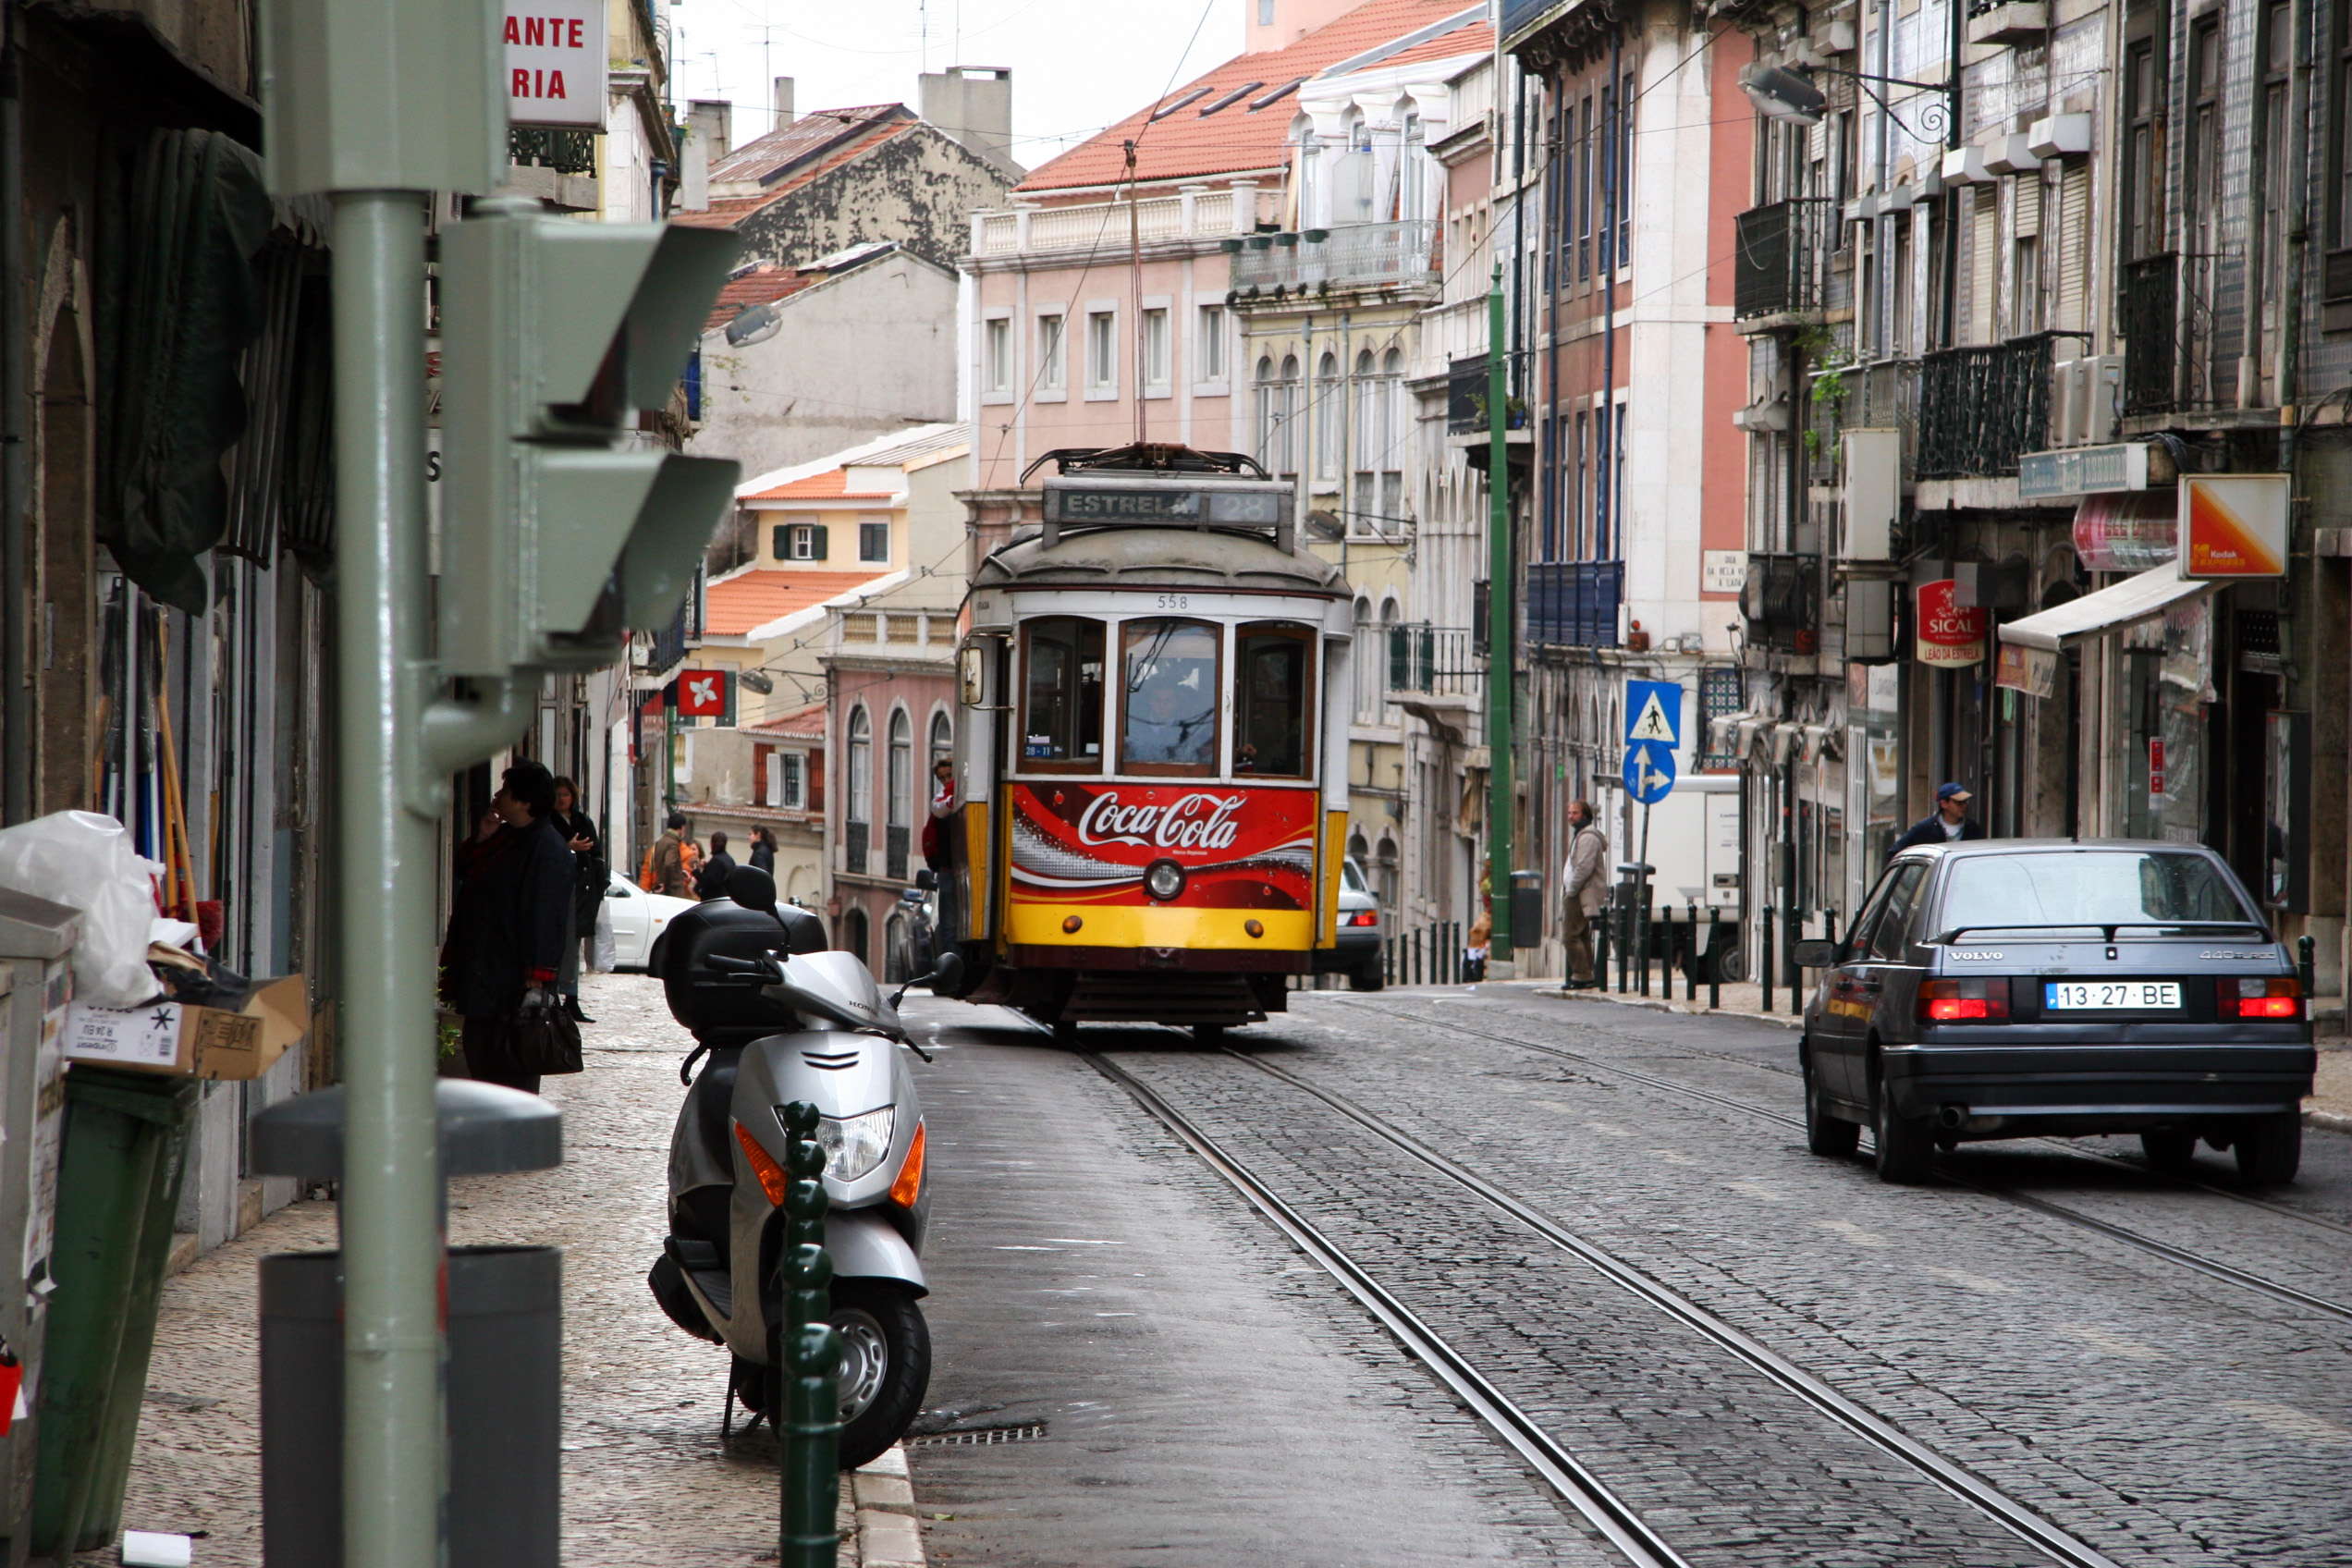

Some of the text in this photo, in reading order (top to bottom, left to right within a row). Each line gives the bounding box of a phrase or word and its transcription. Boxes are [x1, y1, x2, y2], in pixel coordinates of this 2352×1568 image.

[512, 67, 567, 99] RIA
[1222, 495, 1266, 521] 28
[1158, 594, 1188, 609] 558
[1929, 618, 1977, 634] SICAL
[1942, 647, 1952, 659] DA
[1952, 647, 1980, 660] ESTRELA
[1078, 791, 1248, 849] Coca-Cola
[1949, 951, 2004, 962] VOLVO
[2063, 986, 2088, 1006] 13
[2101, 986, 2127, 1006] 27
[2143, 986, 2175, 1005] BE
